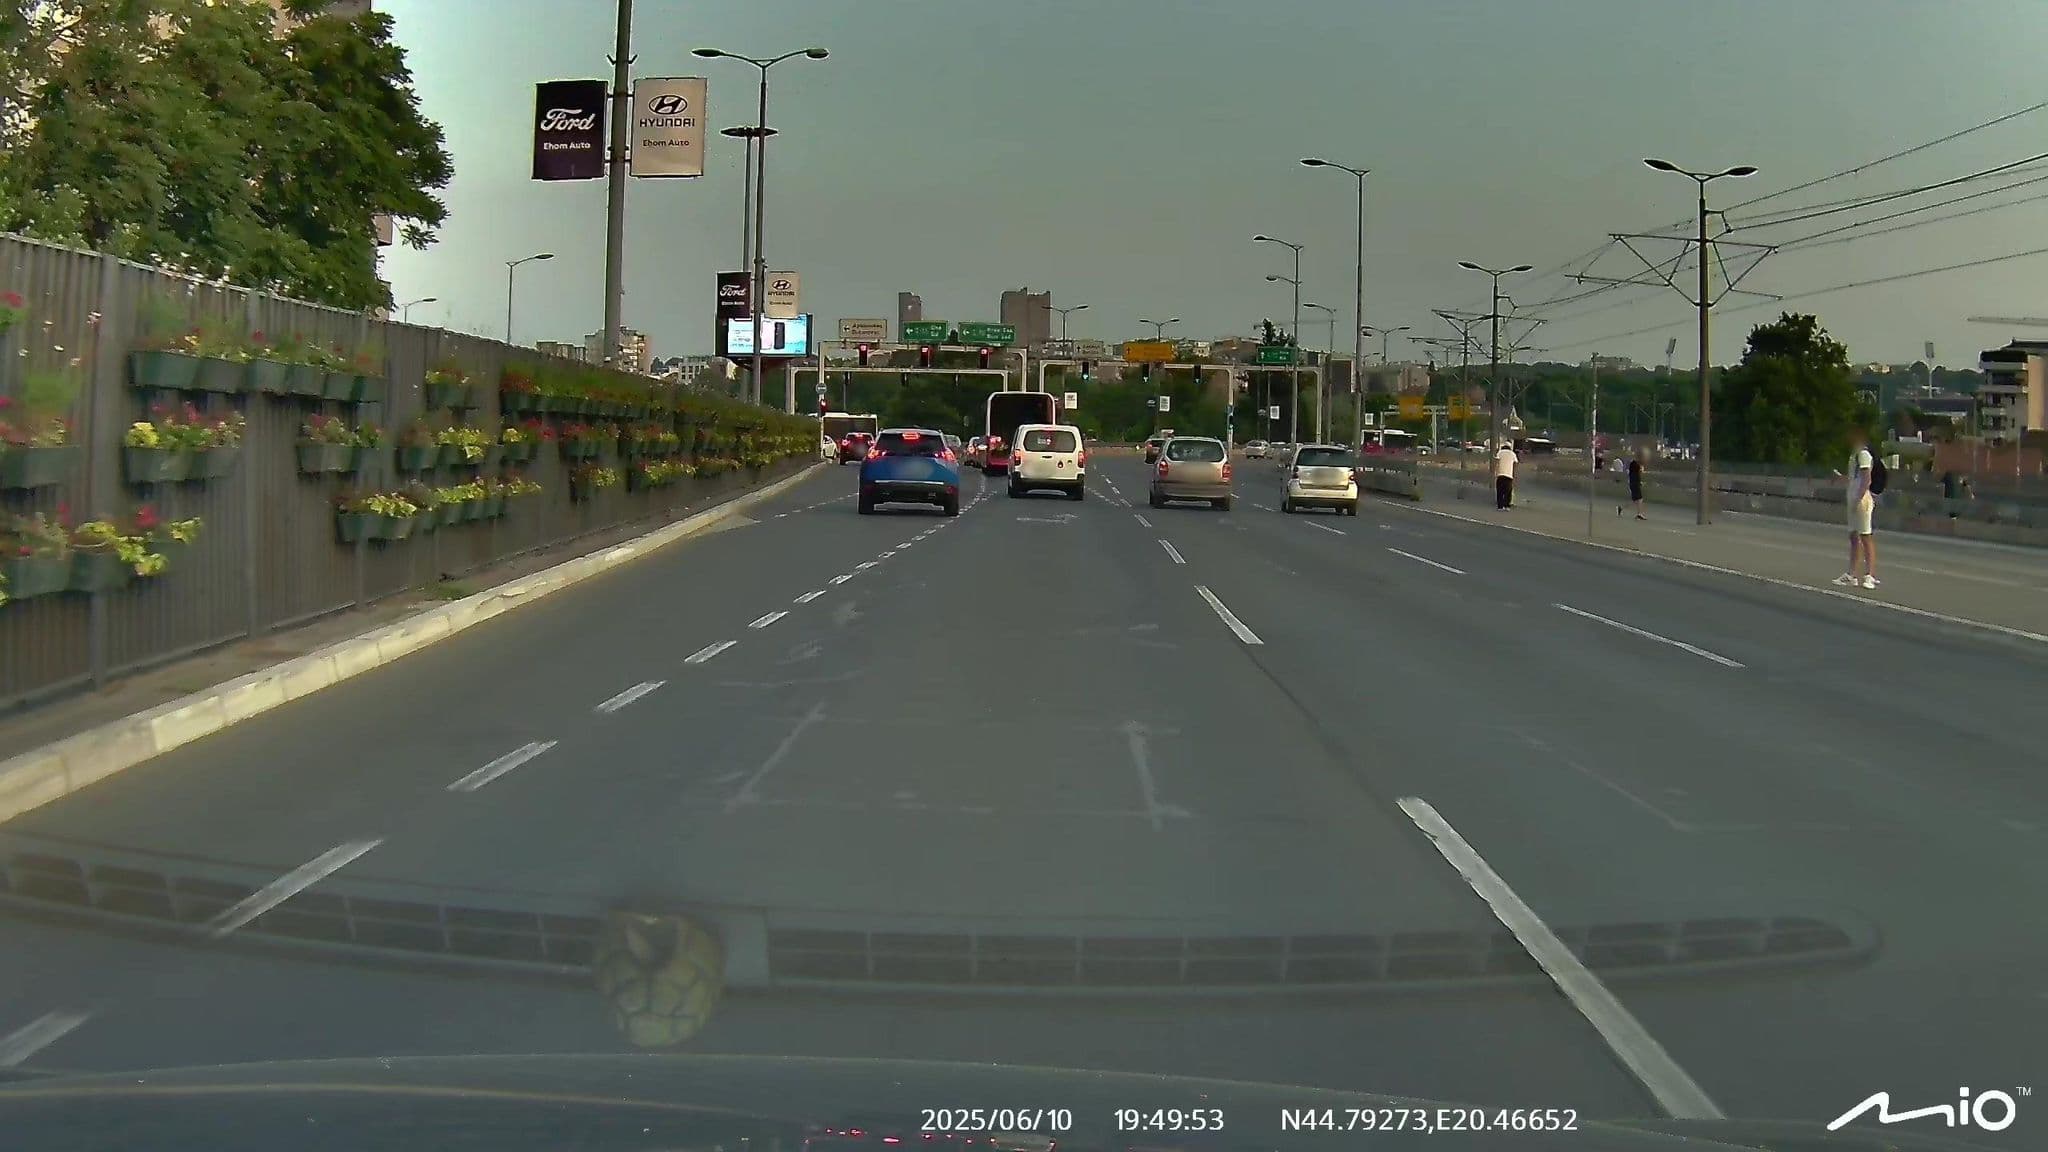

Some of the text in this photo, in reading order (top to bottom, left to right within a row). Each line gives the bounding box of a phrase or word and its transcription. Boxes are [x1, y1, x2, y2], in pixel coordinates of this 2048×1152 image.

[540, 108, 595, 131] Ford
[639, 118, 696, 128] HYUNDAI
[719, 284, 747, 297] Ford
